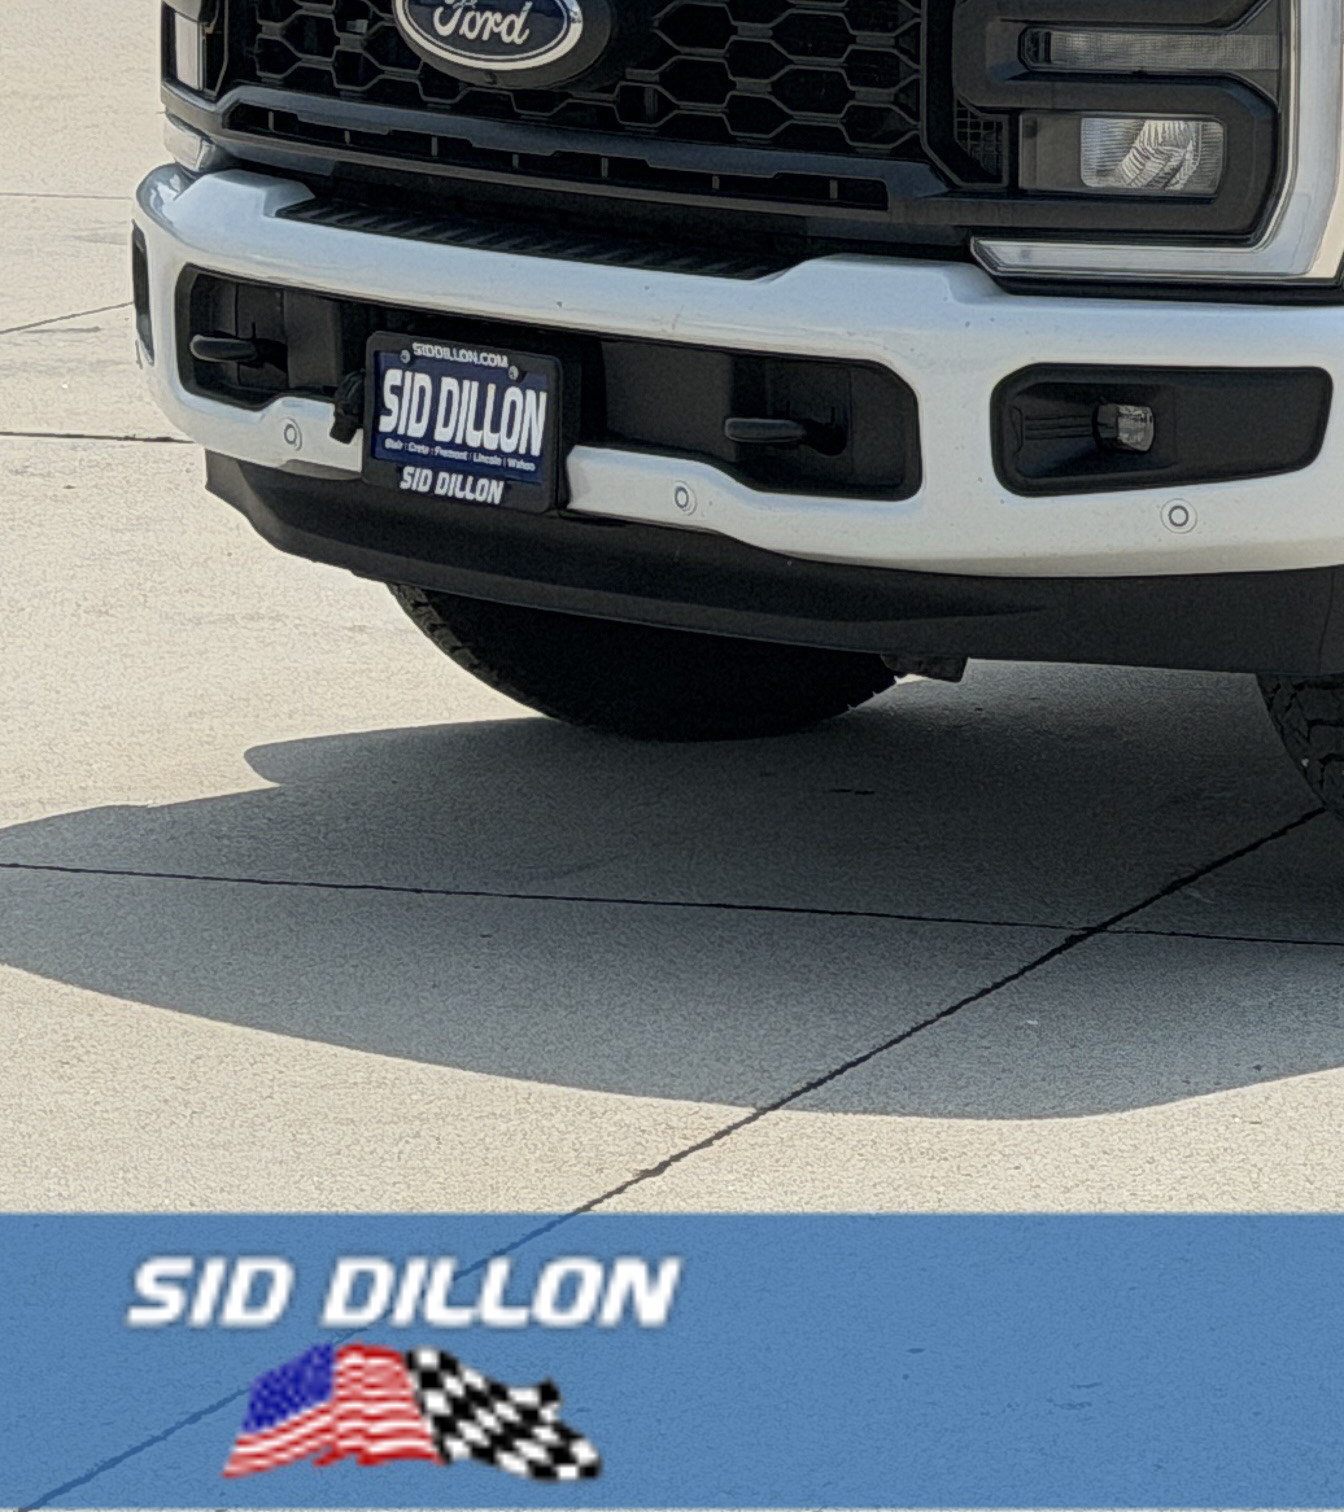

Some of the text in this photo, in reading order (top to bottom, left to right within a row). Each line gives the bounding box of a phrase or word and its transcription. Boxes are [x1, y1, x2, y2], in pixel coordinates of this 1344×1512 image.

[412, 341, 509, 368] SIDDILLON.COM
[378, 368, 548, 457] SID DILLON
[400, 465, 504, 505] SID DILLON
